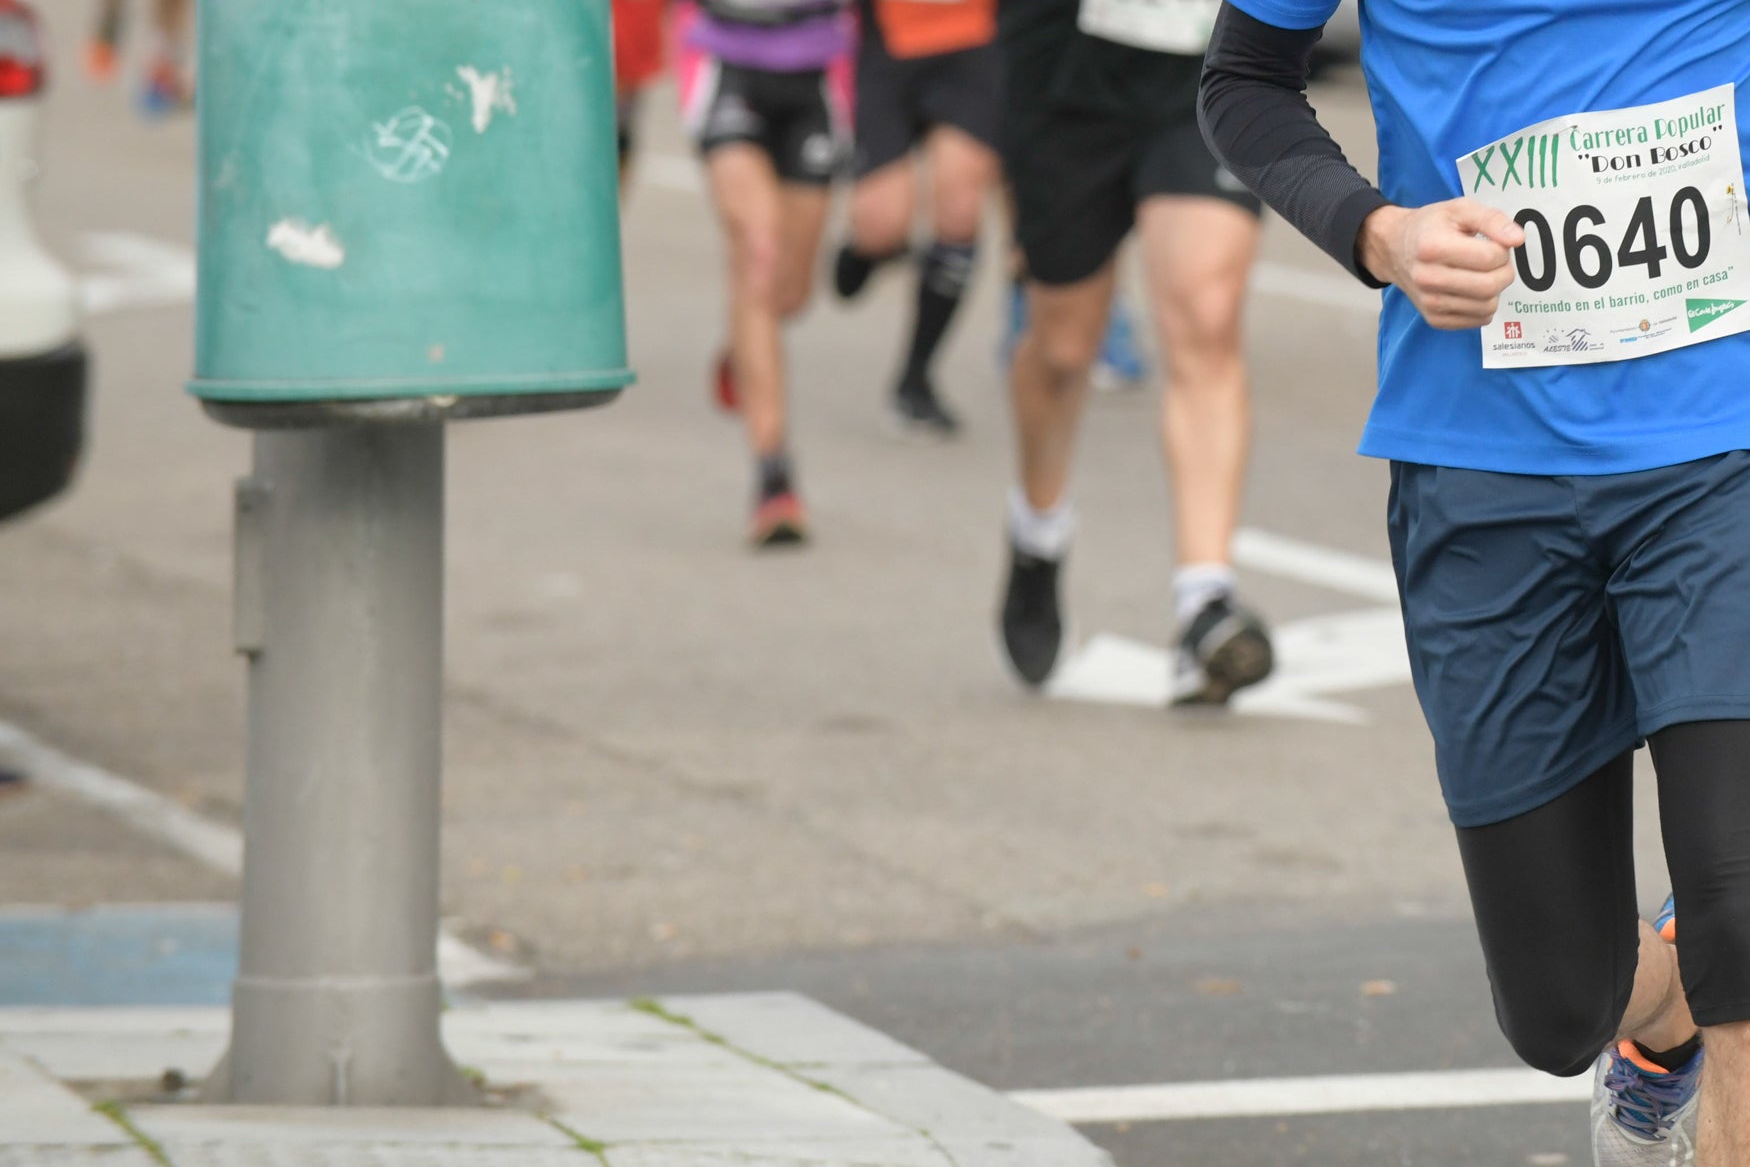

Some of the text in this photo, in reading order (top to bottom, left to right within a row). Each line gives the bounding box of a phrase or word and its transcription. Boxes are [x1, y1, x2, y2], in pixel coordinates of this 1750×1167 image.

[1471, 103, 1726, 194] XXIII Carrera Popular
[1578, 125, 1723, 173] "Don Bosco"
[1514, 186, 1711, 293] 0640
[1576, 300, 1590, 312] en
[1593, 296, 1605, 310] el
[1609, 293, 1650, 308] barrio,
[1653, 285, 1683, 301] como
[1686, 278, 1700, 291] en
[1493, 341, 1536, 351] salesianos
